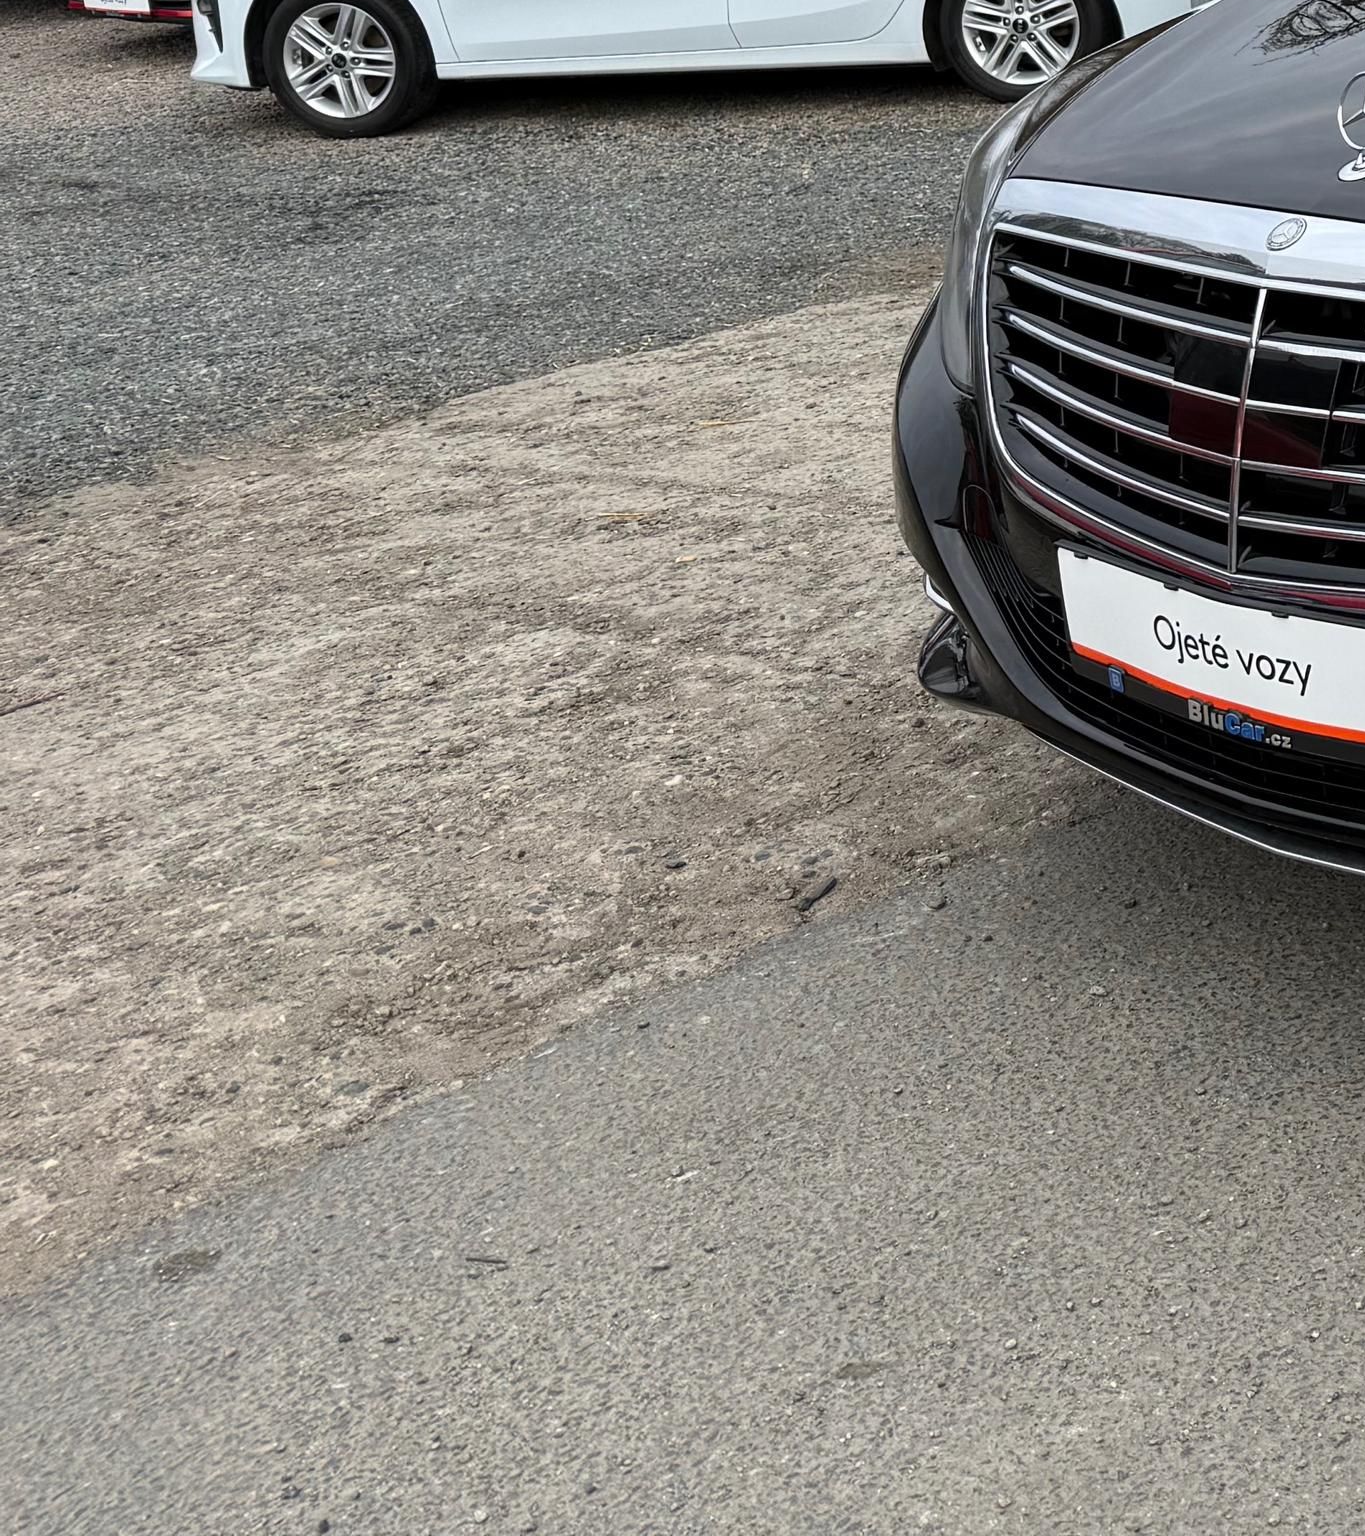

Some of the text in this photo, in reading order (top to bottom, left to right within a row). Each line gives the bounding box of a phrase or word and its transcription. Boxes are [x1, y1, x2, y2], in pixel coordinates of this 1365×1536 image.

[1153, 614, 1312, 697] Ojeté vozy
[1187, 698, 1292, 749] BluCar.cz
